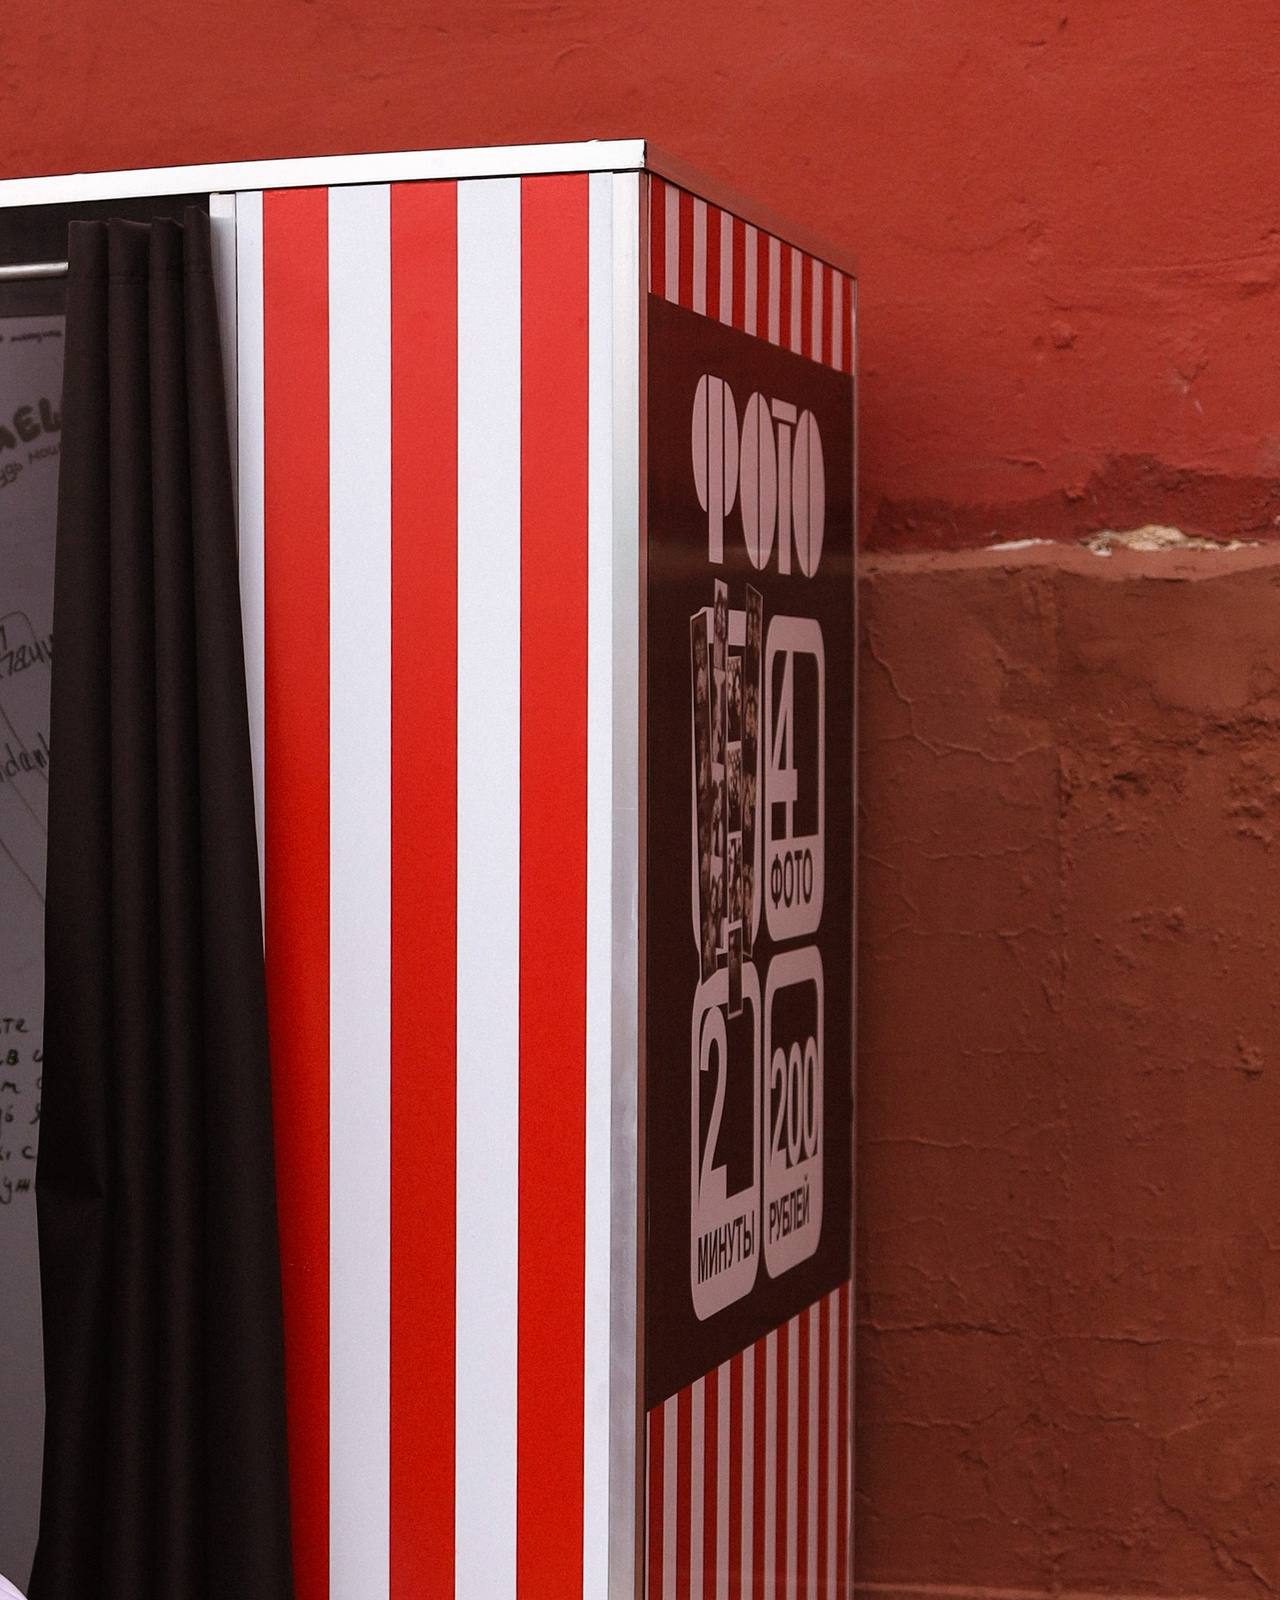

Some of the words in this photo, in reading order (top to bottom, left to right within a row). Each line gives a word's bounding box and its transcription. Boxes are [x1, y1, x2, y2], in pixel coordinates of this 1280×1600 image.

[691, 373, 825, 578] ФОТО
[770, 848, 813, 910] ФОТО
[699, 1005, 727, 1198] 2
[771, 1036, 818, 1170] 200
[697, 1209, 756, 1285] МИНУТЫ
[769, 1173, 810, 1245] РУБЛЕЙ
